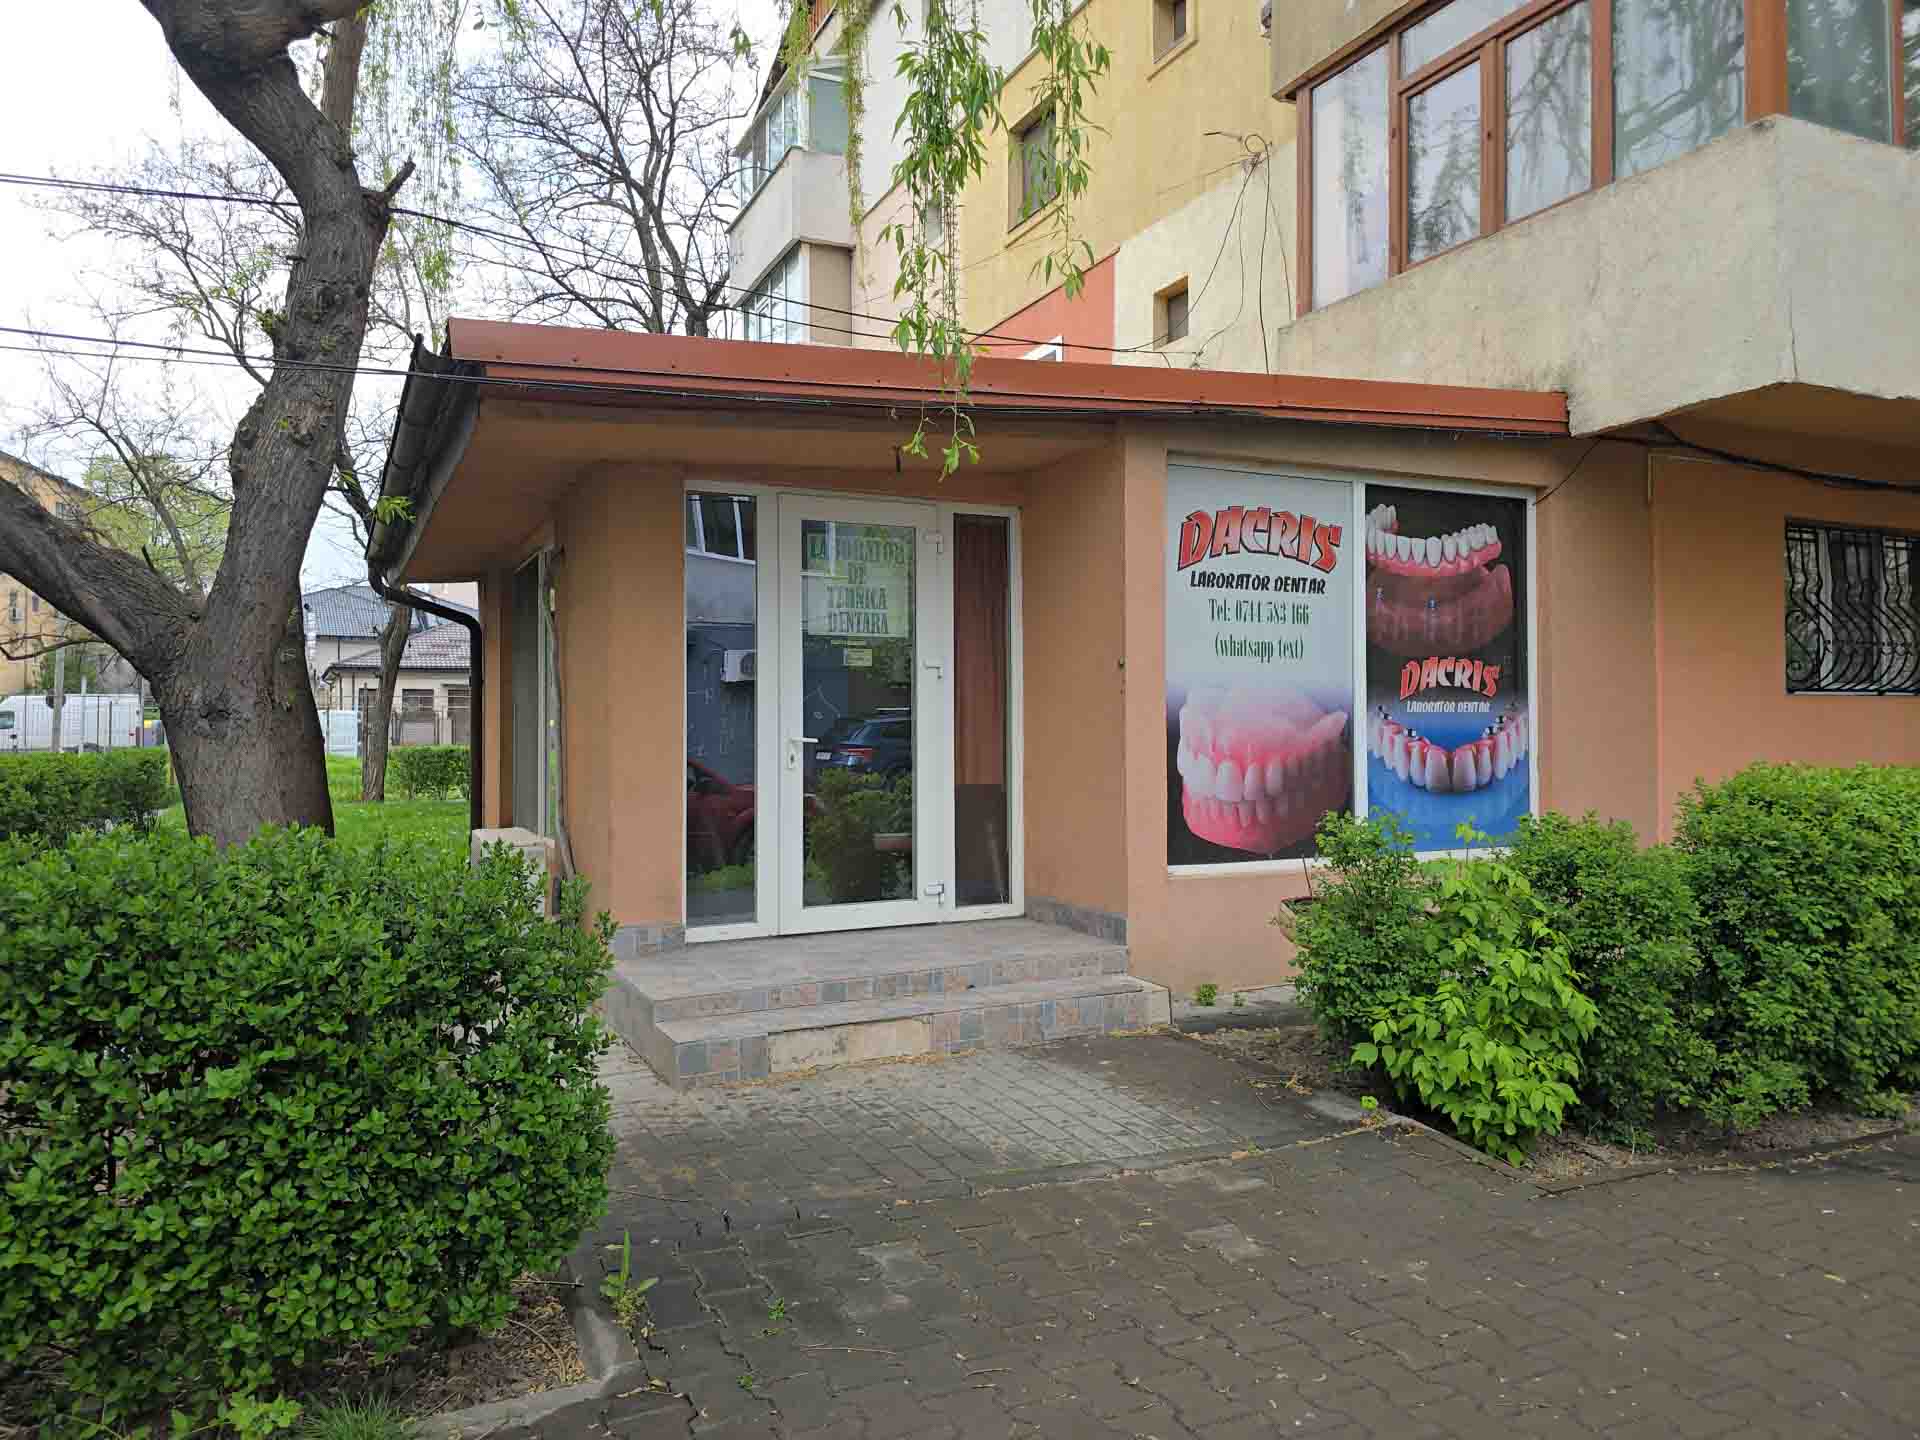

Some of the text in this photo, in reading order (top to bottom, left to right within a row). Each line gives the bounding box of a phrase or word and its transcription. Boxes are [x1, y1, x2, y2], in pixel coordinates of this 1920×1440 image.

[1177, 505, 1342, 574] DACRIS
[1190, 570, 1327, 595] LABORATOR DENTAR
[1208, 598, 1231, 622] Tel:
[1266, 601, 1287, 624] 583
[1215, 631, 1304, 664] (whatsapp text)
[1399, 656, 1502, 702] DACRIS
[1407, 700, 1490, 713] LABORATOR DENTAR
